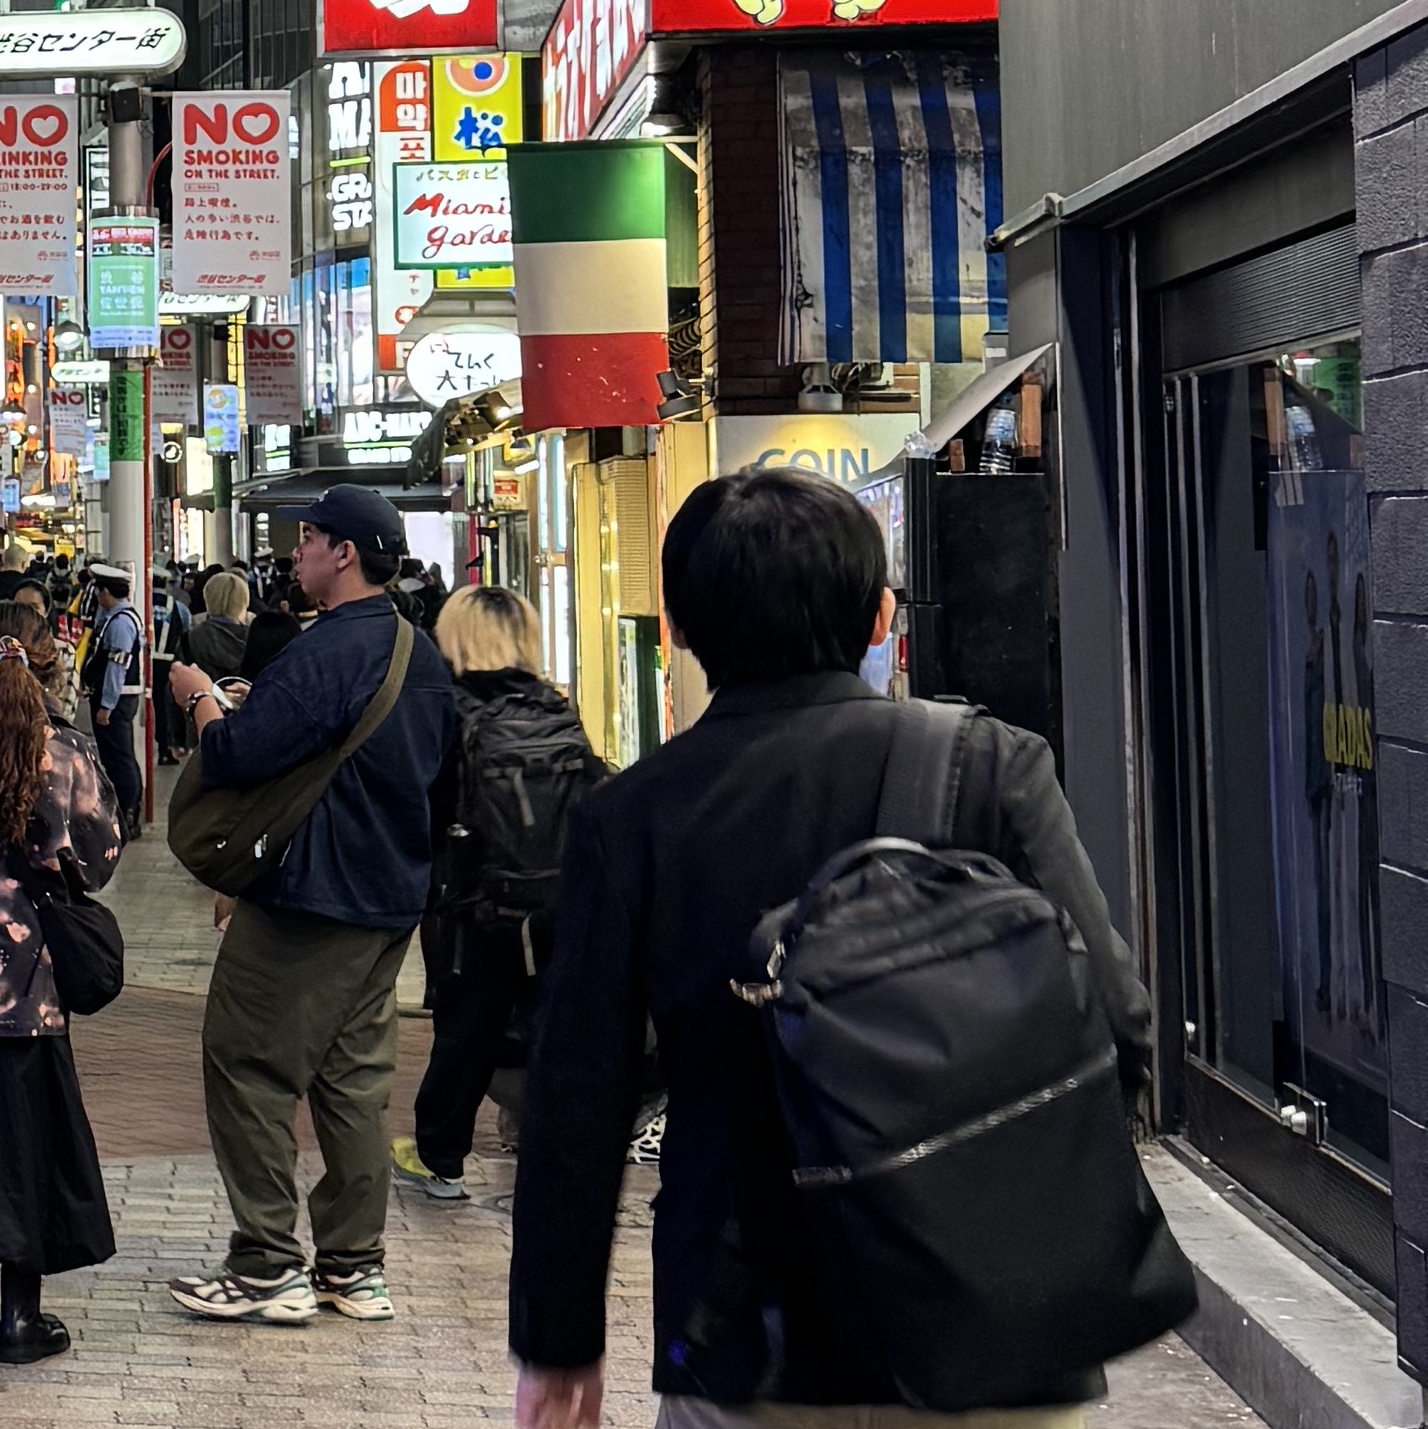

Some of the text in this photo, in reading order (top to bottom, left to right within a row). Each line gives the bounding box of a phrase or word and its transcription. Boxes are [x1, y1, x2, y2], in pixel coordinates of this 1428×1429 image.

[184, 103, 281, 146] NO
[183, 149, 280, 166] SMOKING
[184, 168, 203, 179] ON
[207, 168, 230, 179] THE
[403, 192, 510, 219] Miami
[247, 328, 296, 351] NO
[51, 390, 85, 406] NO
